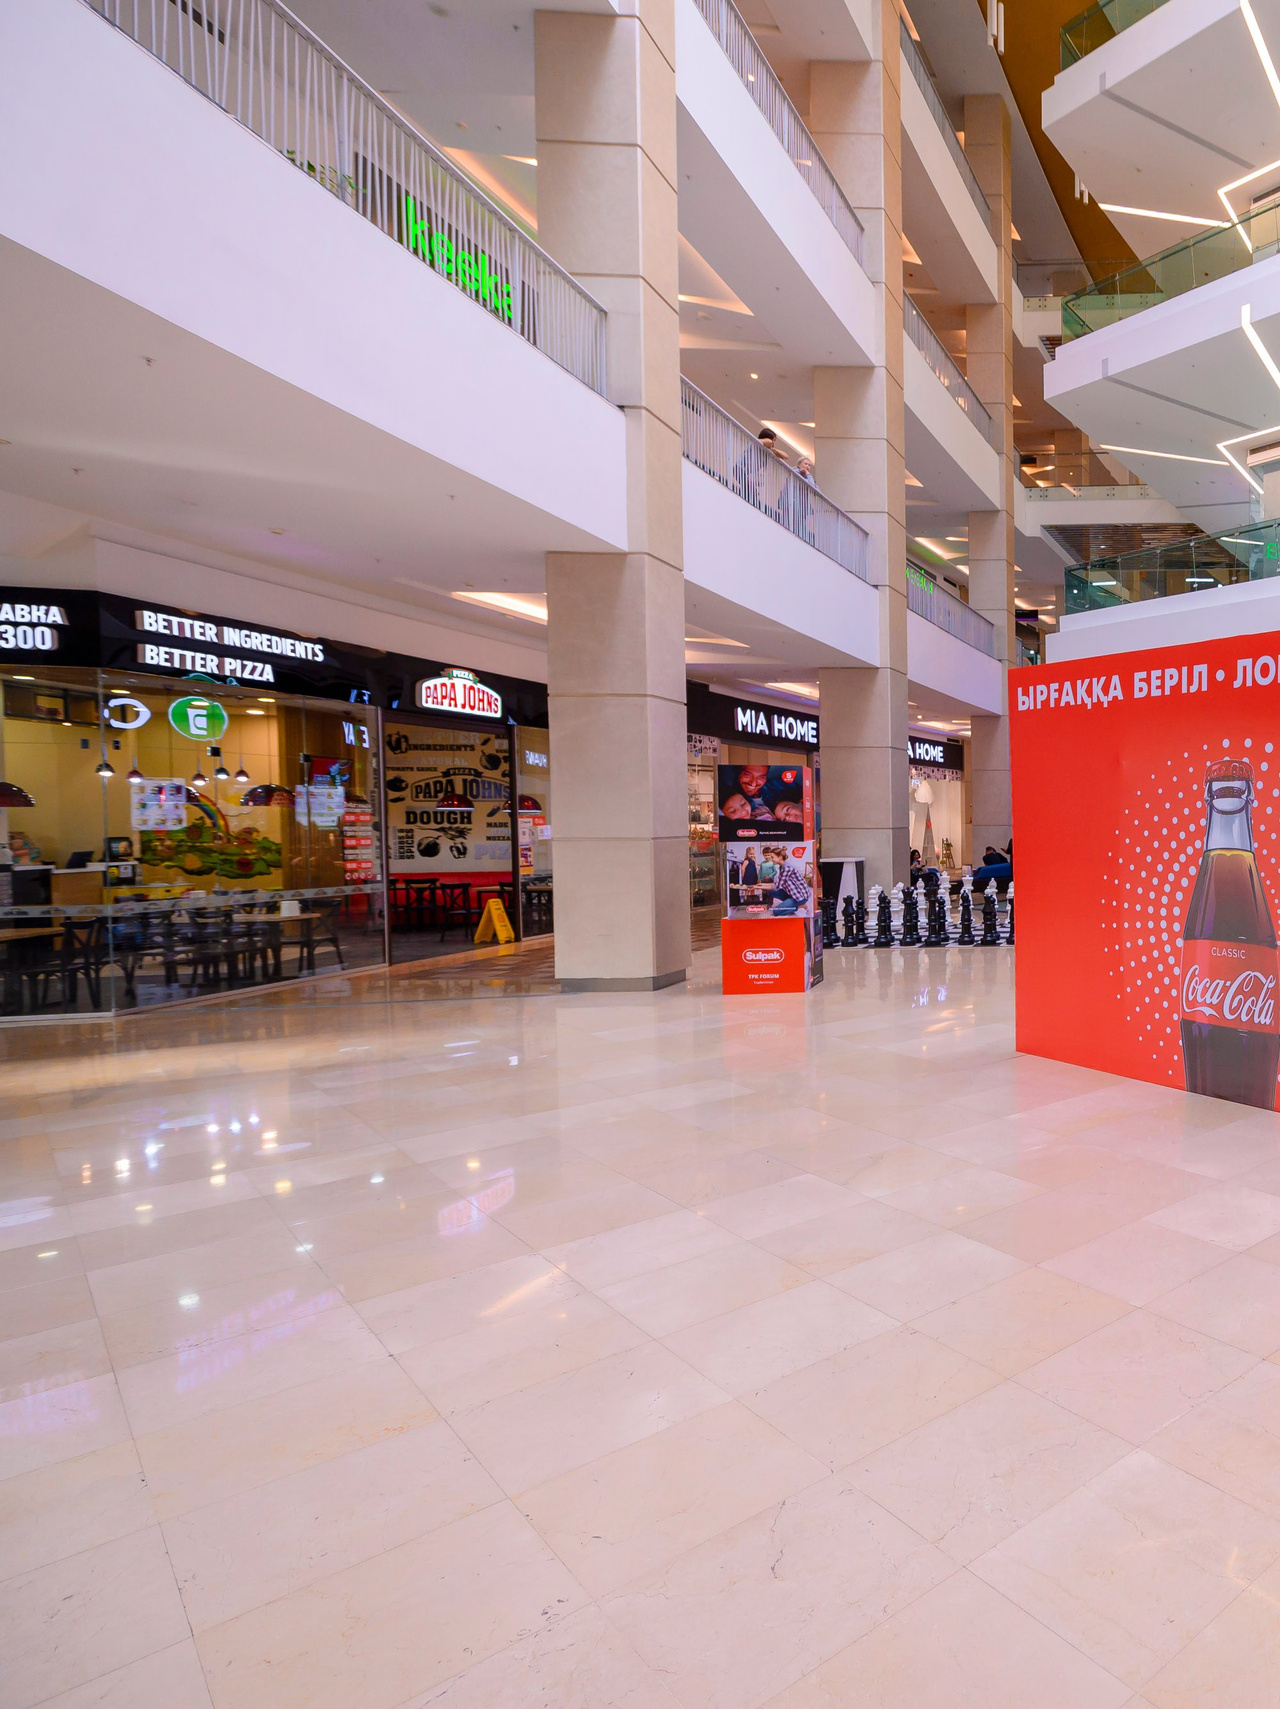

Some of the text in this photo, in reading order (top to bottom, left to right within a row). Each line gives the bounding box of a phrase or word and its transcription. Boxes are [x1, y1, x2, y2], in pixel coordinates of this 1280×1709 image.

[0, 625, 53, 650] 300
[142, 610, 325, 662] BETTER INGREDIENTS
[144, 643, 275, 683] BETTER PIZZA
[453, 670, 474, 681] PIZZA
[425, 682, 499, 714] PAPA JOHNS
[1017, 674, 1124, 711] ЫРҒАҚҚА
[1133, 663, 1208, 699] БЕРІЛ
[737, 706, 818, 744] MIA HOME
[408, 743, 476, 752] INGREDIENTS
[916, 742, 945, 763] HOME
[414, 779, 456, 799] PAPA
[405, 811, 473, 825] DOUGH
[405, 828, 414, 860] SPICES
[745, 951, 780, 962] Sulpak
[1211, 947, 1246, 959] CLASSIC
[1182, 964, 1276, 1026] Coca-Cola
